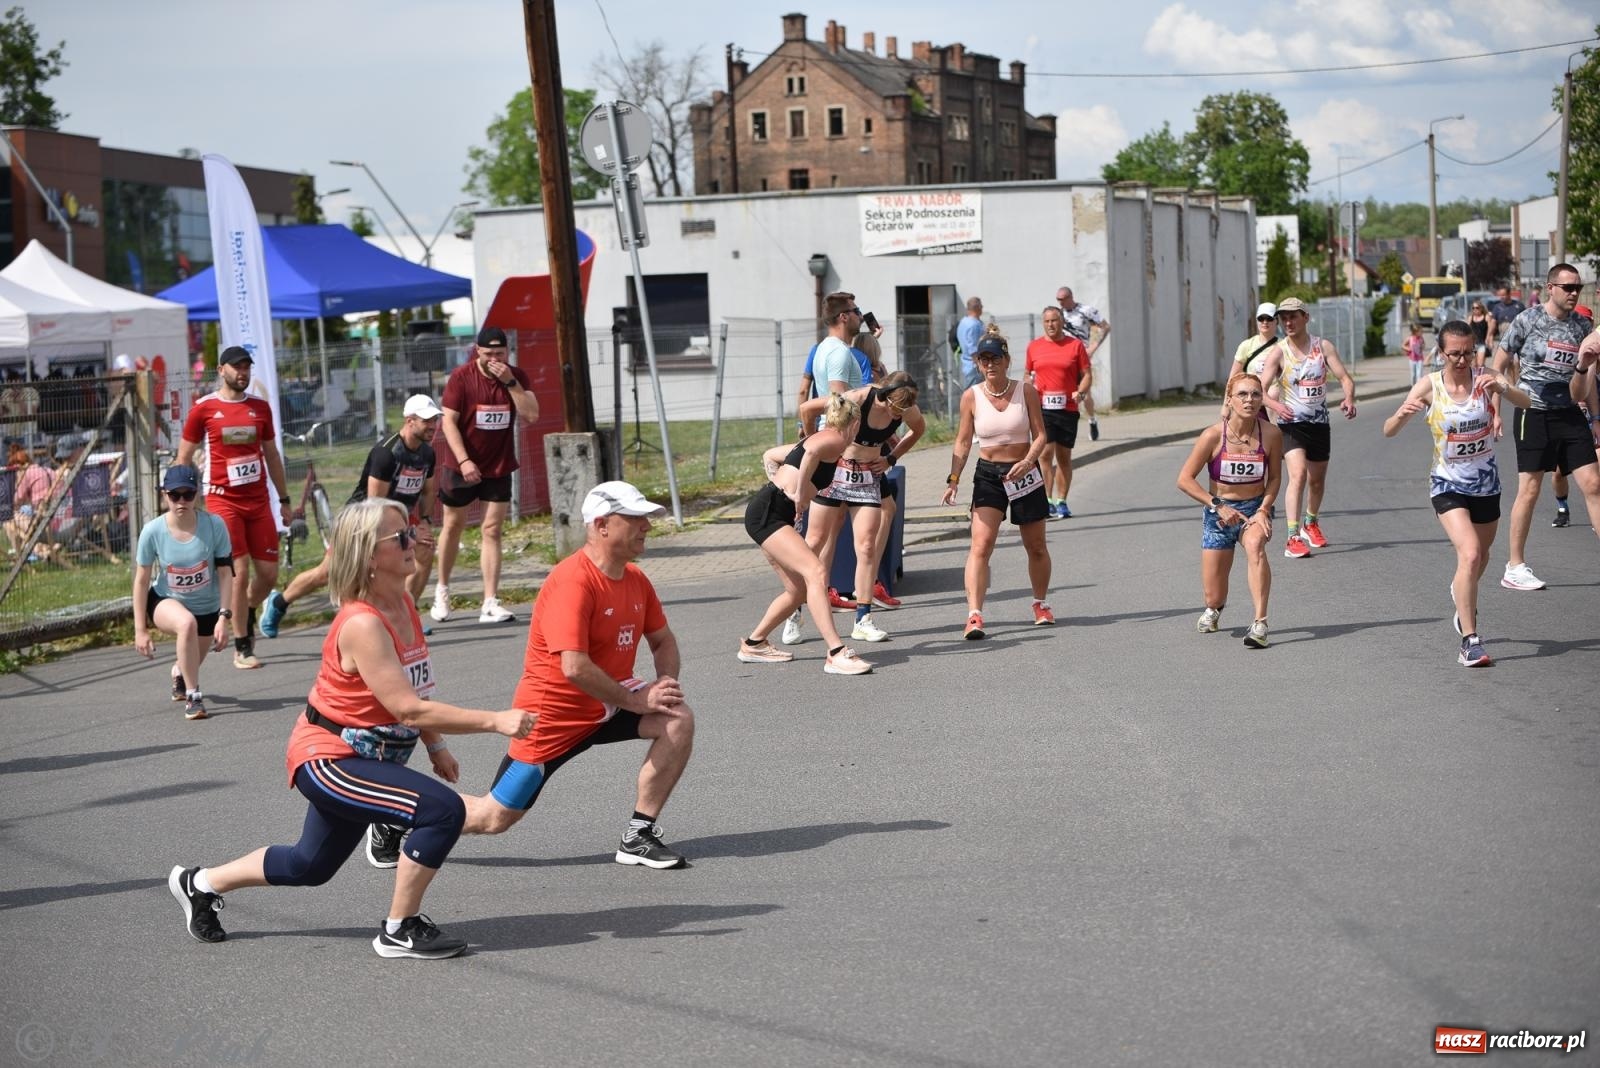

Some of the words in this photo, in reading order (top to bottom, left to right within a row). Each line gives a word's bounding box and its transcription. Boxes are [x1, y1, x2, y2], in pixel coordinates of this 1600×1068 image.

[876, 195, 914, 207] TRWA
[919, 191, 962, 206] NABÓR
[865, 209, 902, 221] Sekcja
[906, 207, 976, 219] Podnoszenia
[865, 220, 914, 232] Ciężarów
[1553, 350, 1574, 364] 212
[1305, 386, 1323, 397] 128
[1047, 396, 1063, 404] 142
[485, 412, 504, 423] 217
[1457, 439, 1485, 456] 232
[235, 463, 257, 478] 124
[1230, 462, 1255, 476] 192
[406, 477, 421, 488] 170
[845, 470, 864, 483] 191
[1012, 473, 1034, 491] 123
[175, 572, 203, 587] 228
[409, 660, 429, 688] 175
